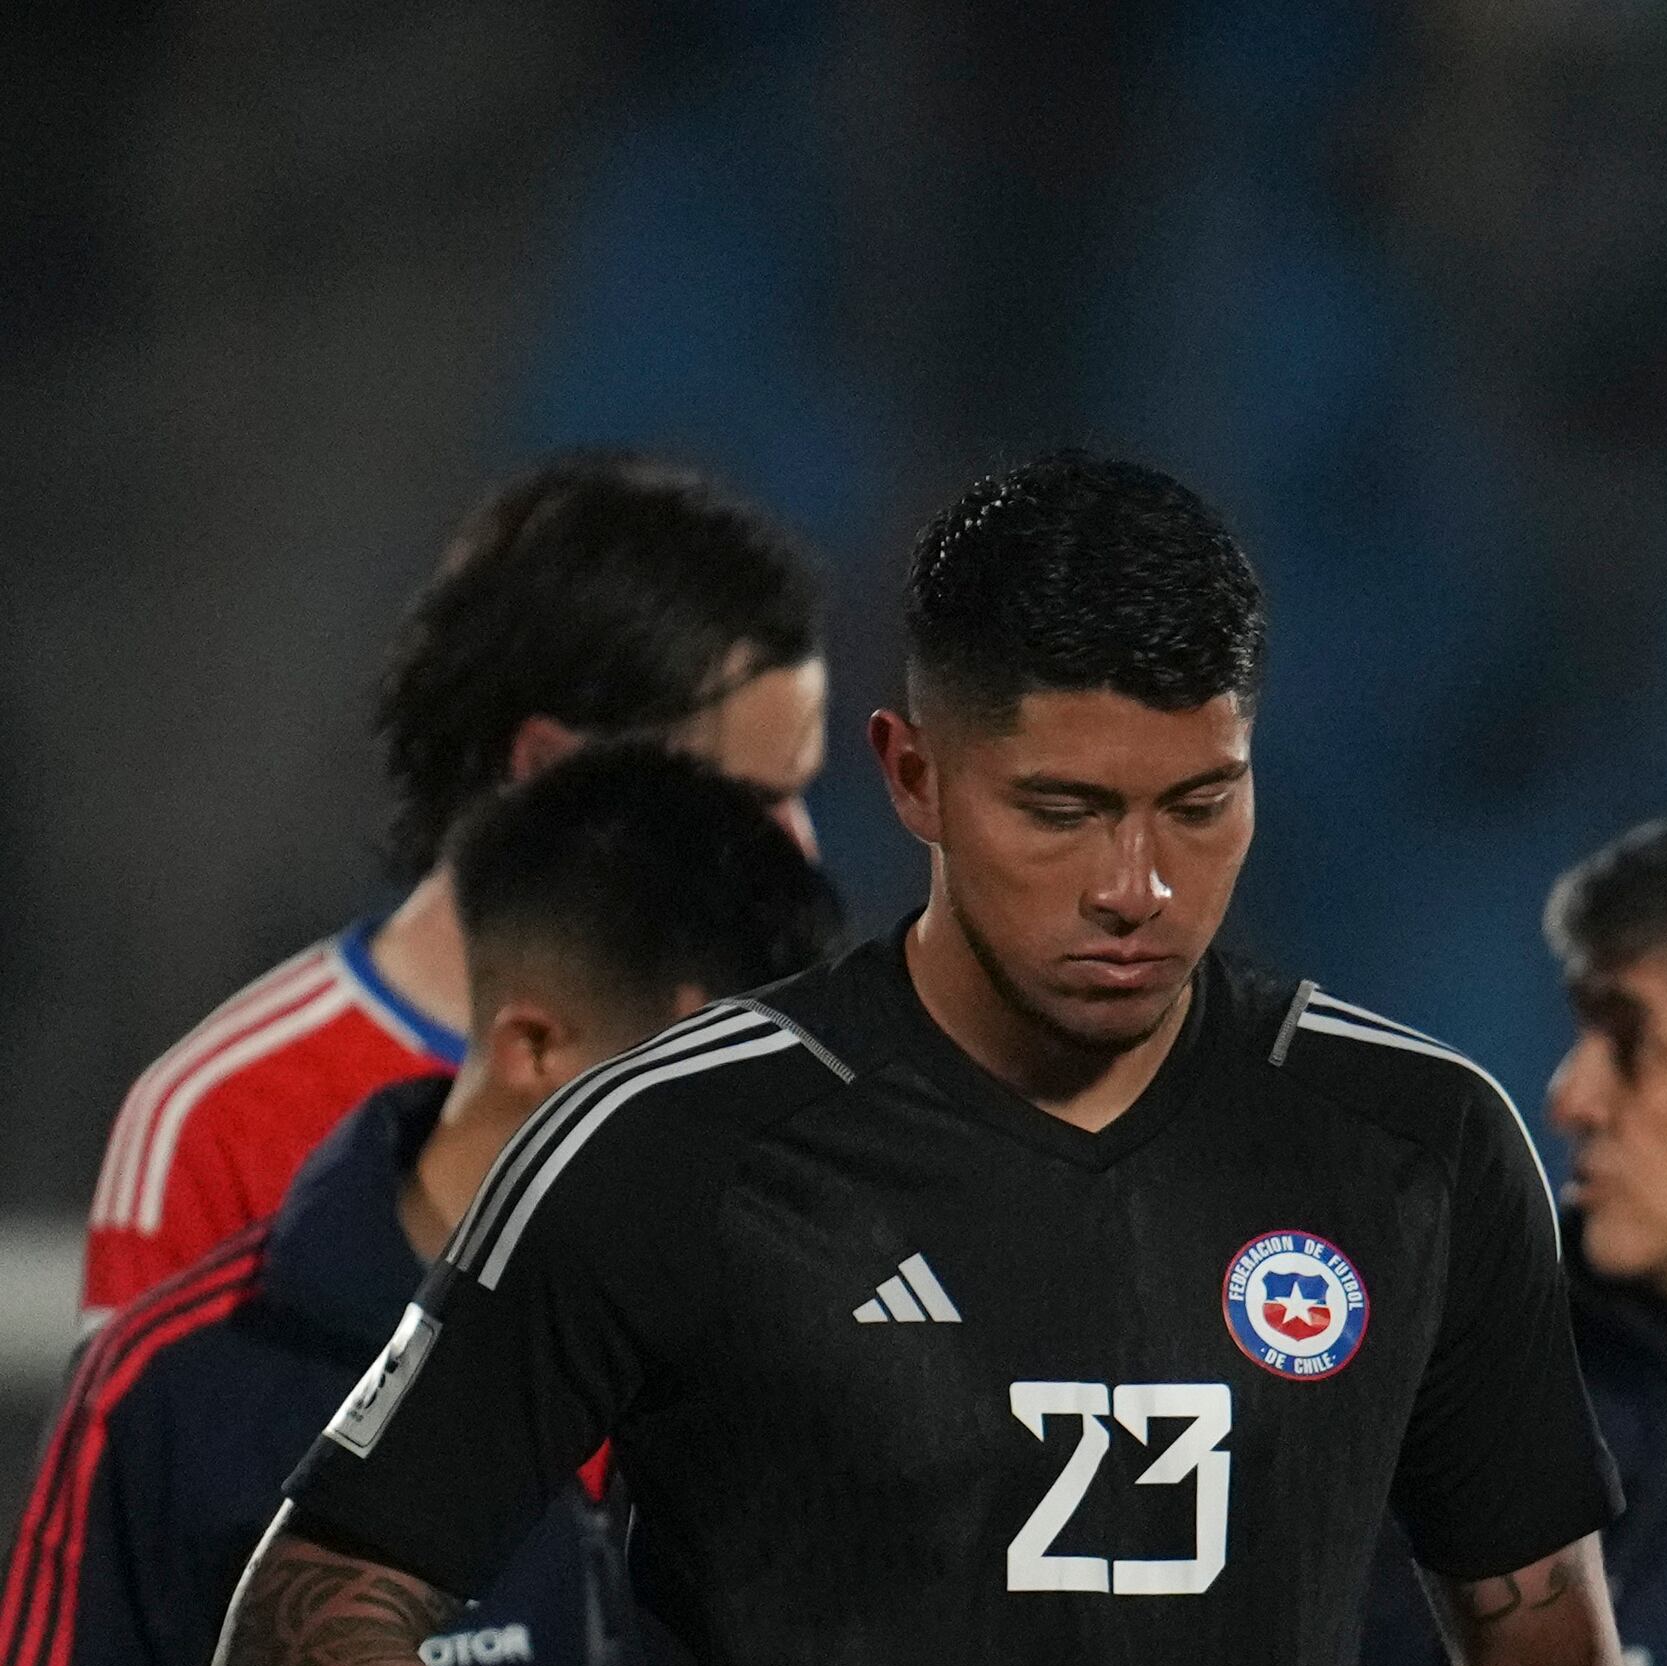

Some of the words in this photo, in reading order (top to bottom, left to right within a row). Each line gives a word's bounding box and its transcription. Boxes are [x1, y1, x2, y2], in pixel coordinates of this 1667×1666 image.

[1228, 1235, 1294, 1301] FEDERACION
[1303, 1239, 1326, 1259] DE
[1327, 1254, 1364, 1312] FUTBOL
[1264, 1352, 1287, 1369] DE
[1293, 1352, 1334, 1374] CHILE
[1007, 1381, 1231, 1594] 23
